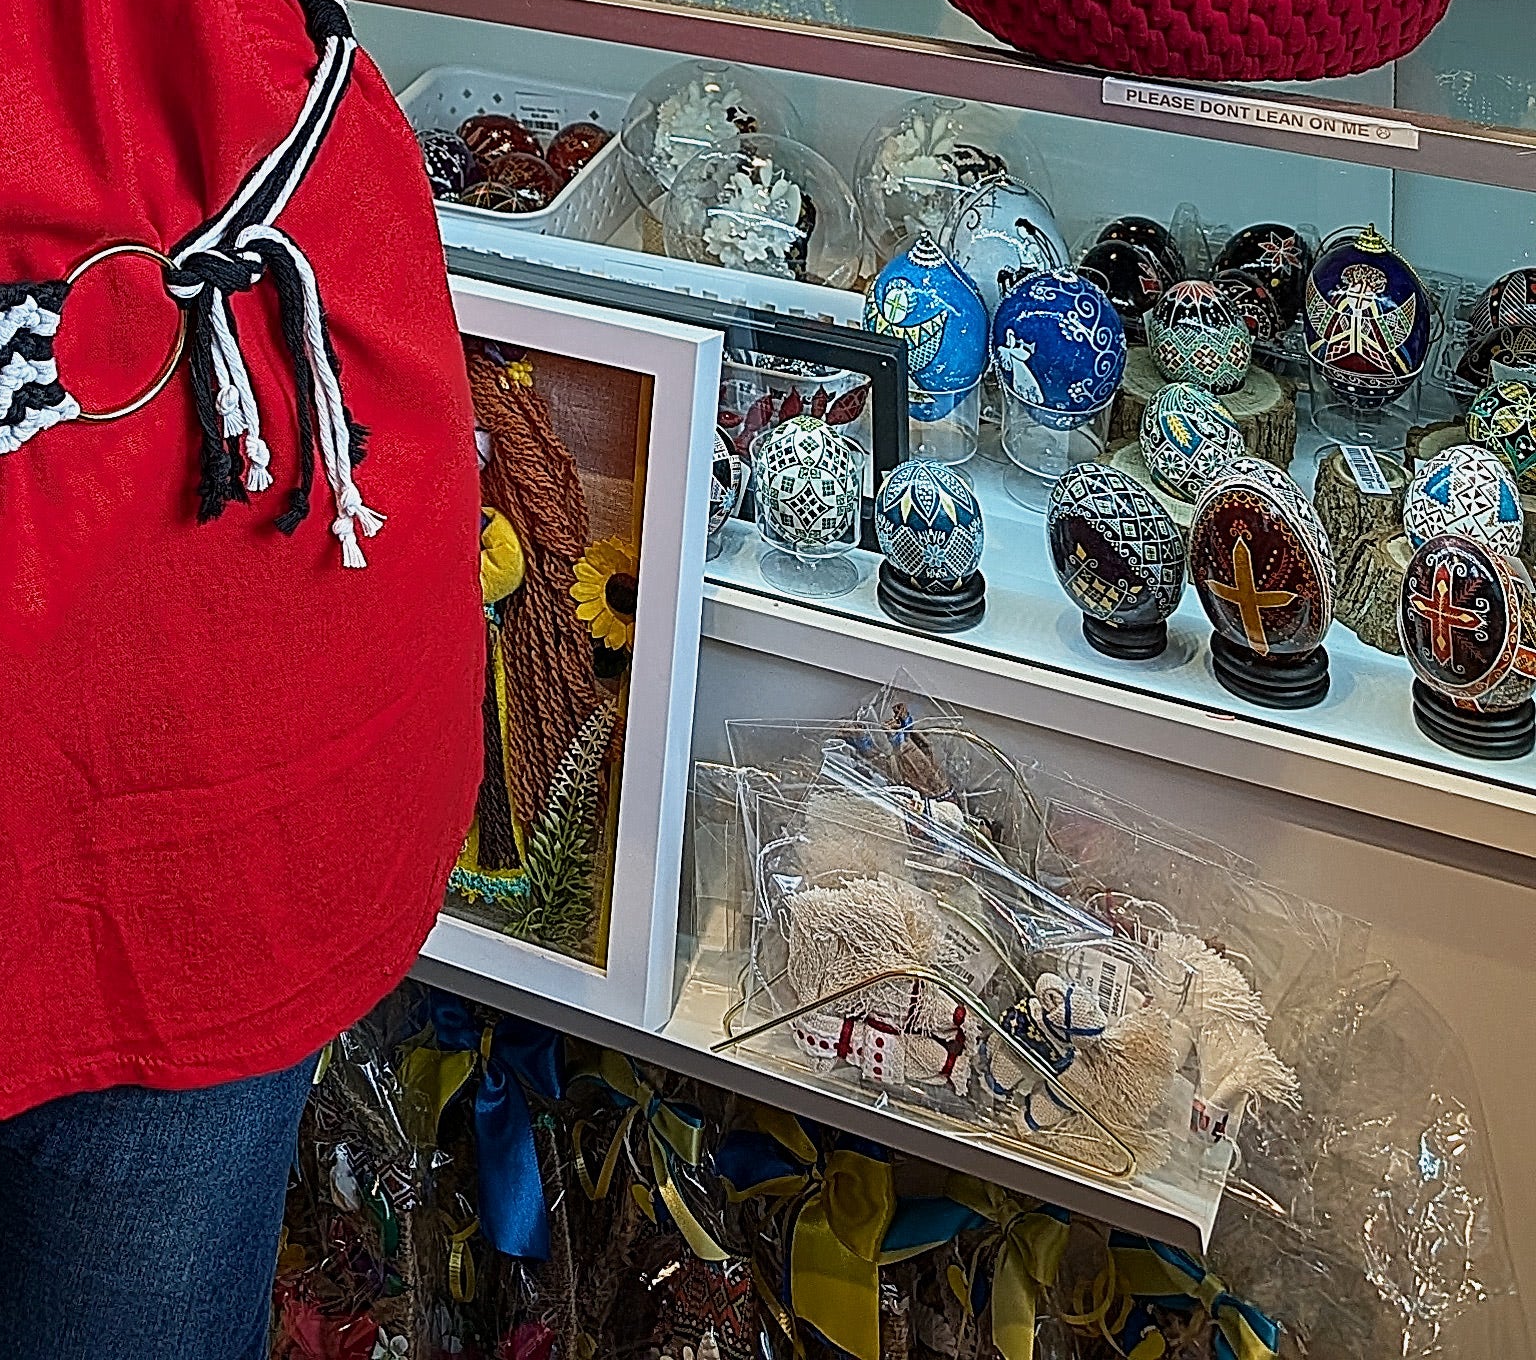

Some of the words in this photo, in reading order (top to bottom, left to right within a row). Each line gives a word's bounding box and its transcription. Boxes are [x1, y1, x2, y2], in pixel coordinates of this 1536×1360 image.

[1125, 88, 1196, 113] PLEASE
[1199, 99, 1251, 121] DONT
[1255, 107, 1305, 130] LEAN
[1308, 116, 1336, 134] ON
[1341, 120, 1371, 138] ME
